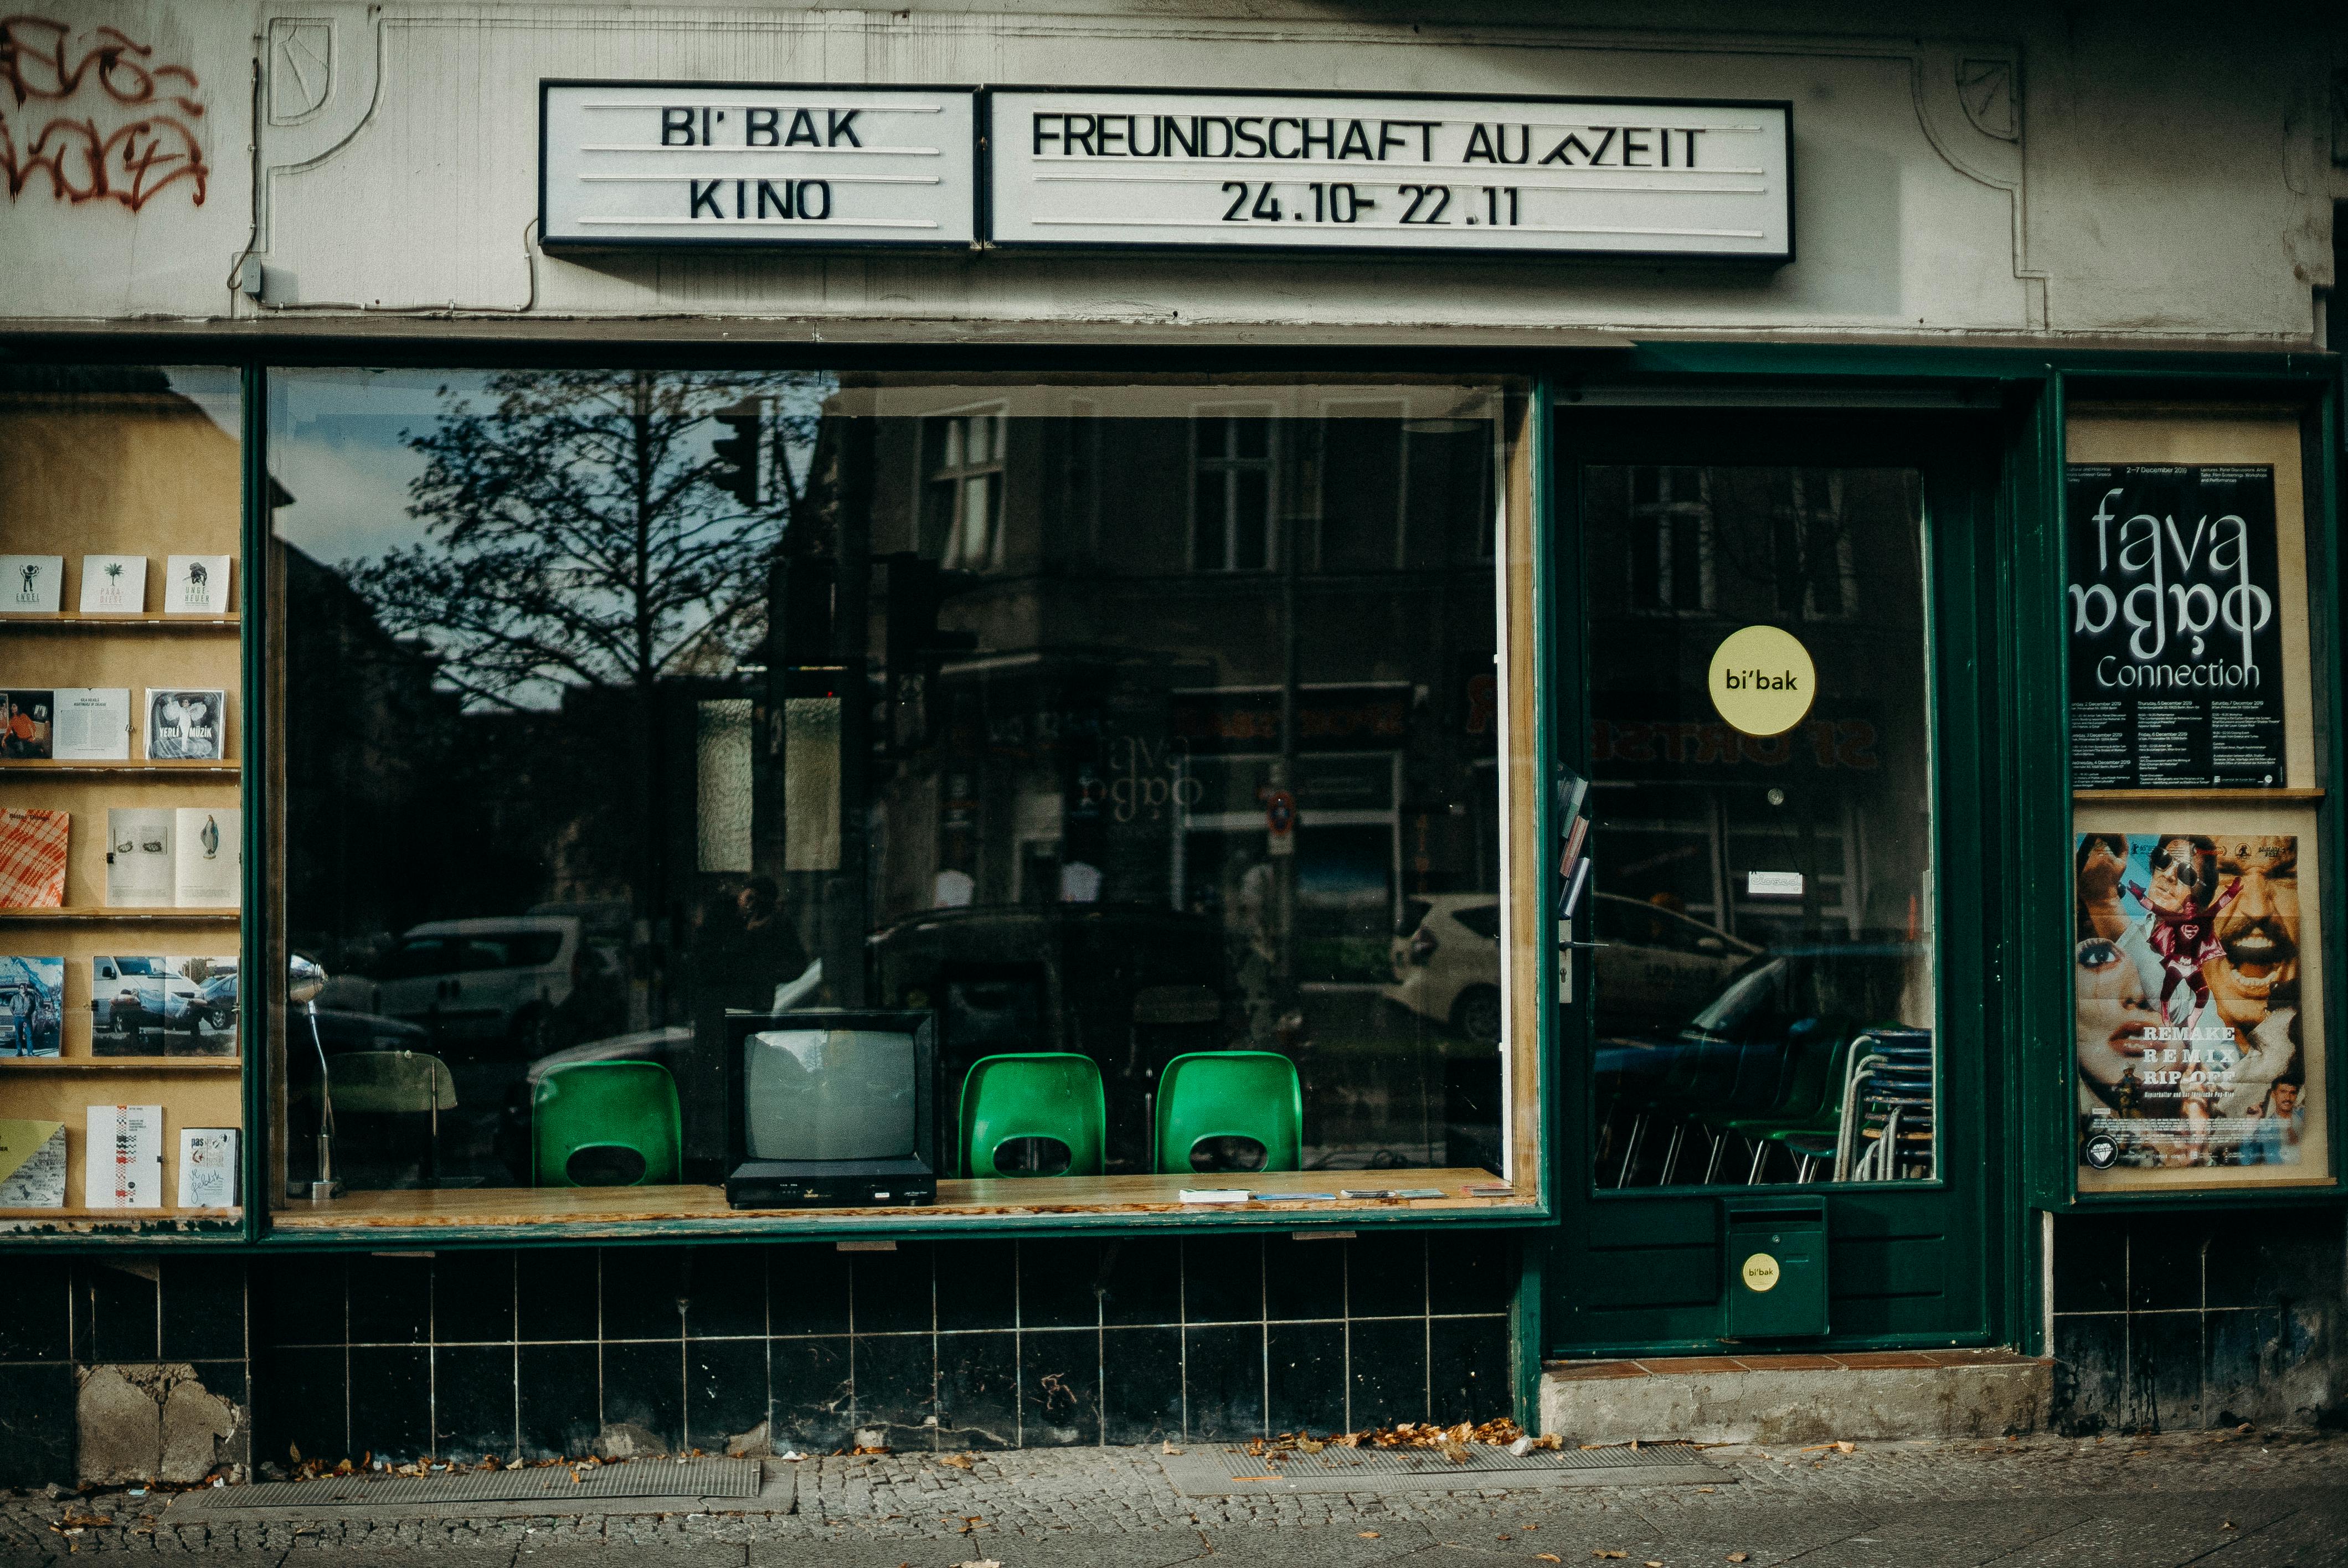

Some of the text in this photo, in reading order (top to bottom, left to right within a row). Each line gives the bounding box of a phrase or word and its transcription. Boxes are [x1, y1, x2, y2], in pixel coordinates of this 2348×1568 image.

[1033, 112, 1442, 162] FREUNDSCHAFT
[690, 179, 831, 220] KINO
[2092, 488, 2249, 572] fava
[16, 592, 39, 601] ENGEL
[184, 594, 210, 602] HEUER
[2097, 655, 2261, 689] Connection
[1751, 874, 1801, 886] closed
[2143, 1027, 2235, 1041] REMAKE
[2143, 1049, 2235, 1063] REMIX
[2143, 1070, 2235, 1085] RIP-OFF
